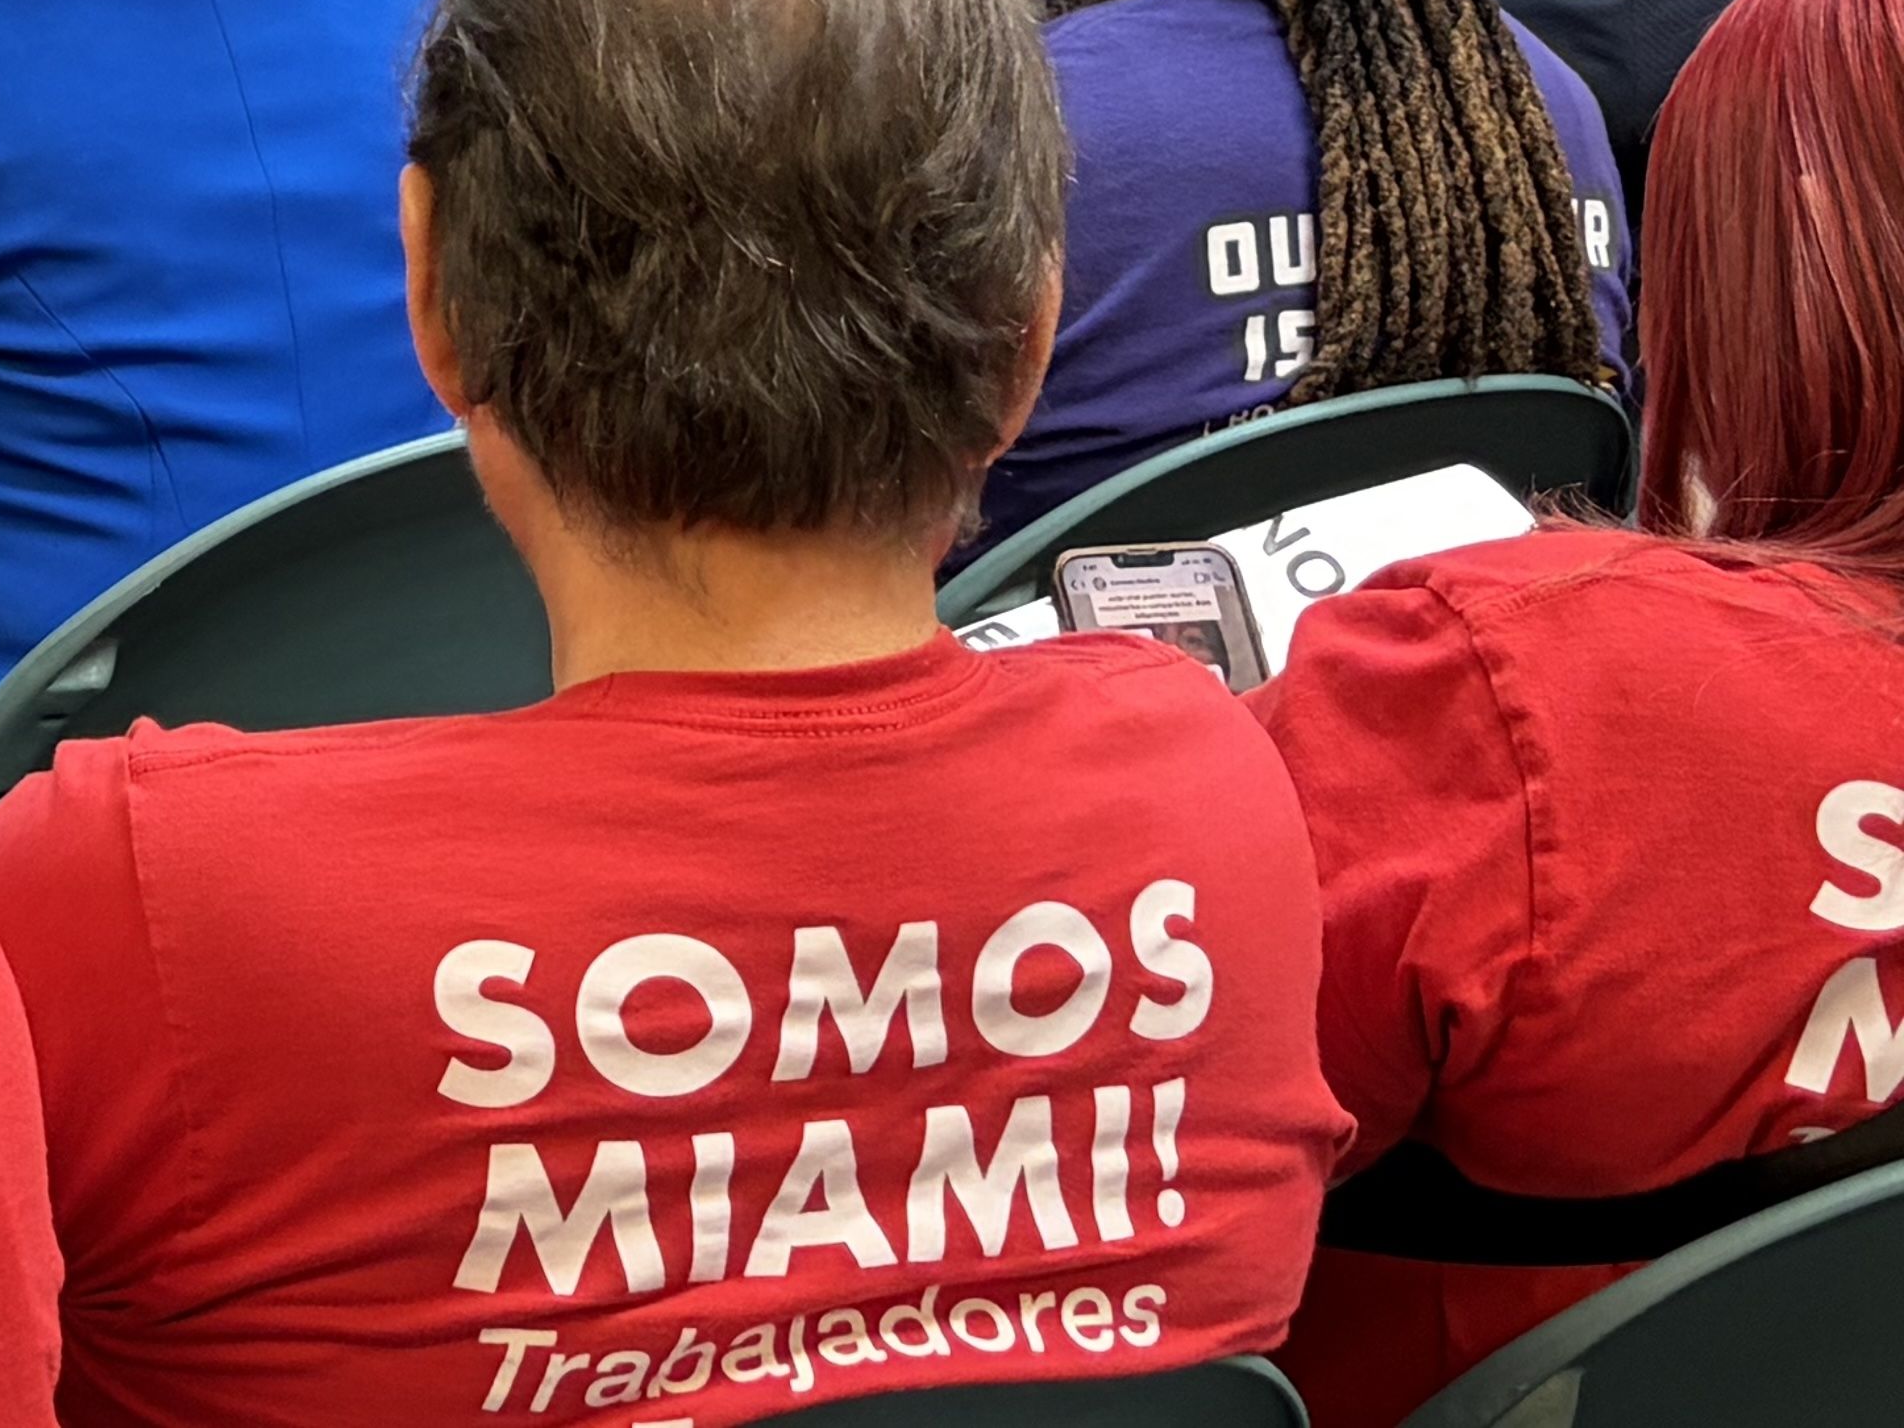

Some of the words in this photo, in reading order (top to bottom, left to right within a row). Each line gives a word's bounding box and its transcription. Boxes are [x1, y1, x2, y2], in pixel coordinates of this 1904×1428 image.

[1243, 308, 1316, 382] IS
[432, 878, 1213, 1108] SOMOS
[453, 1076, 1186, 1296] MIAMI!
[478, 1283, 1167, 1413] Trabajadores
